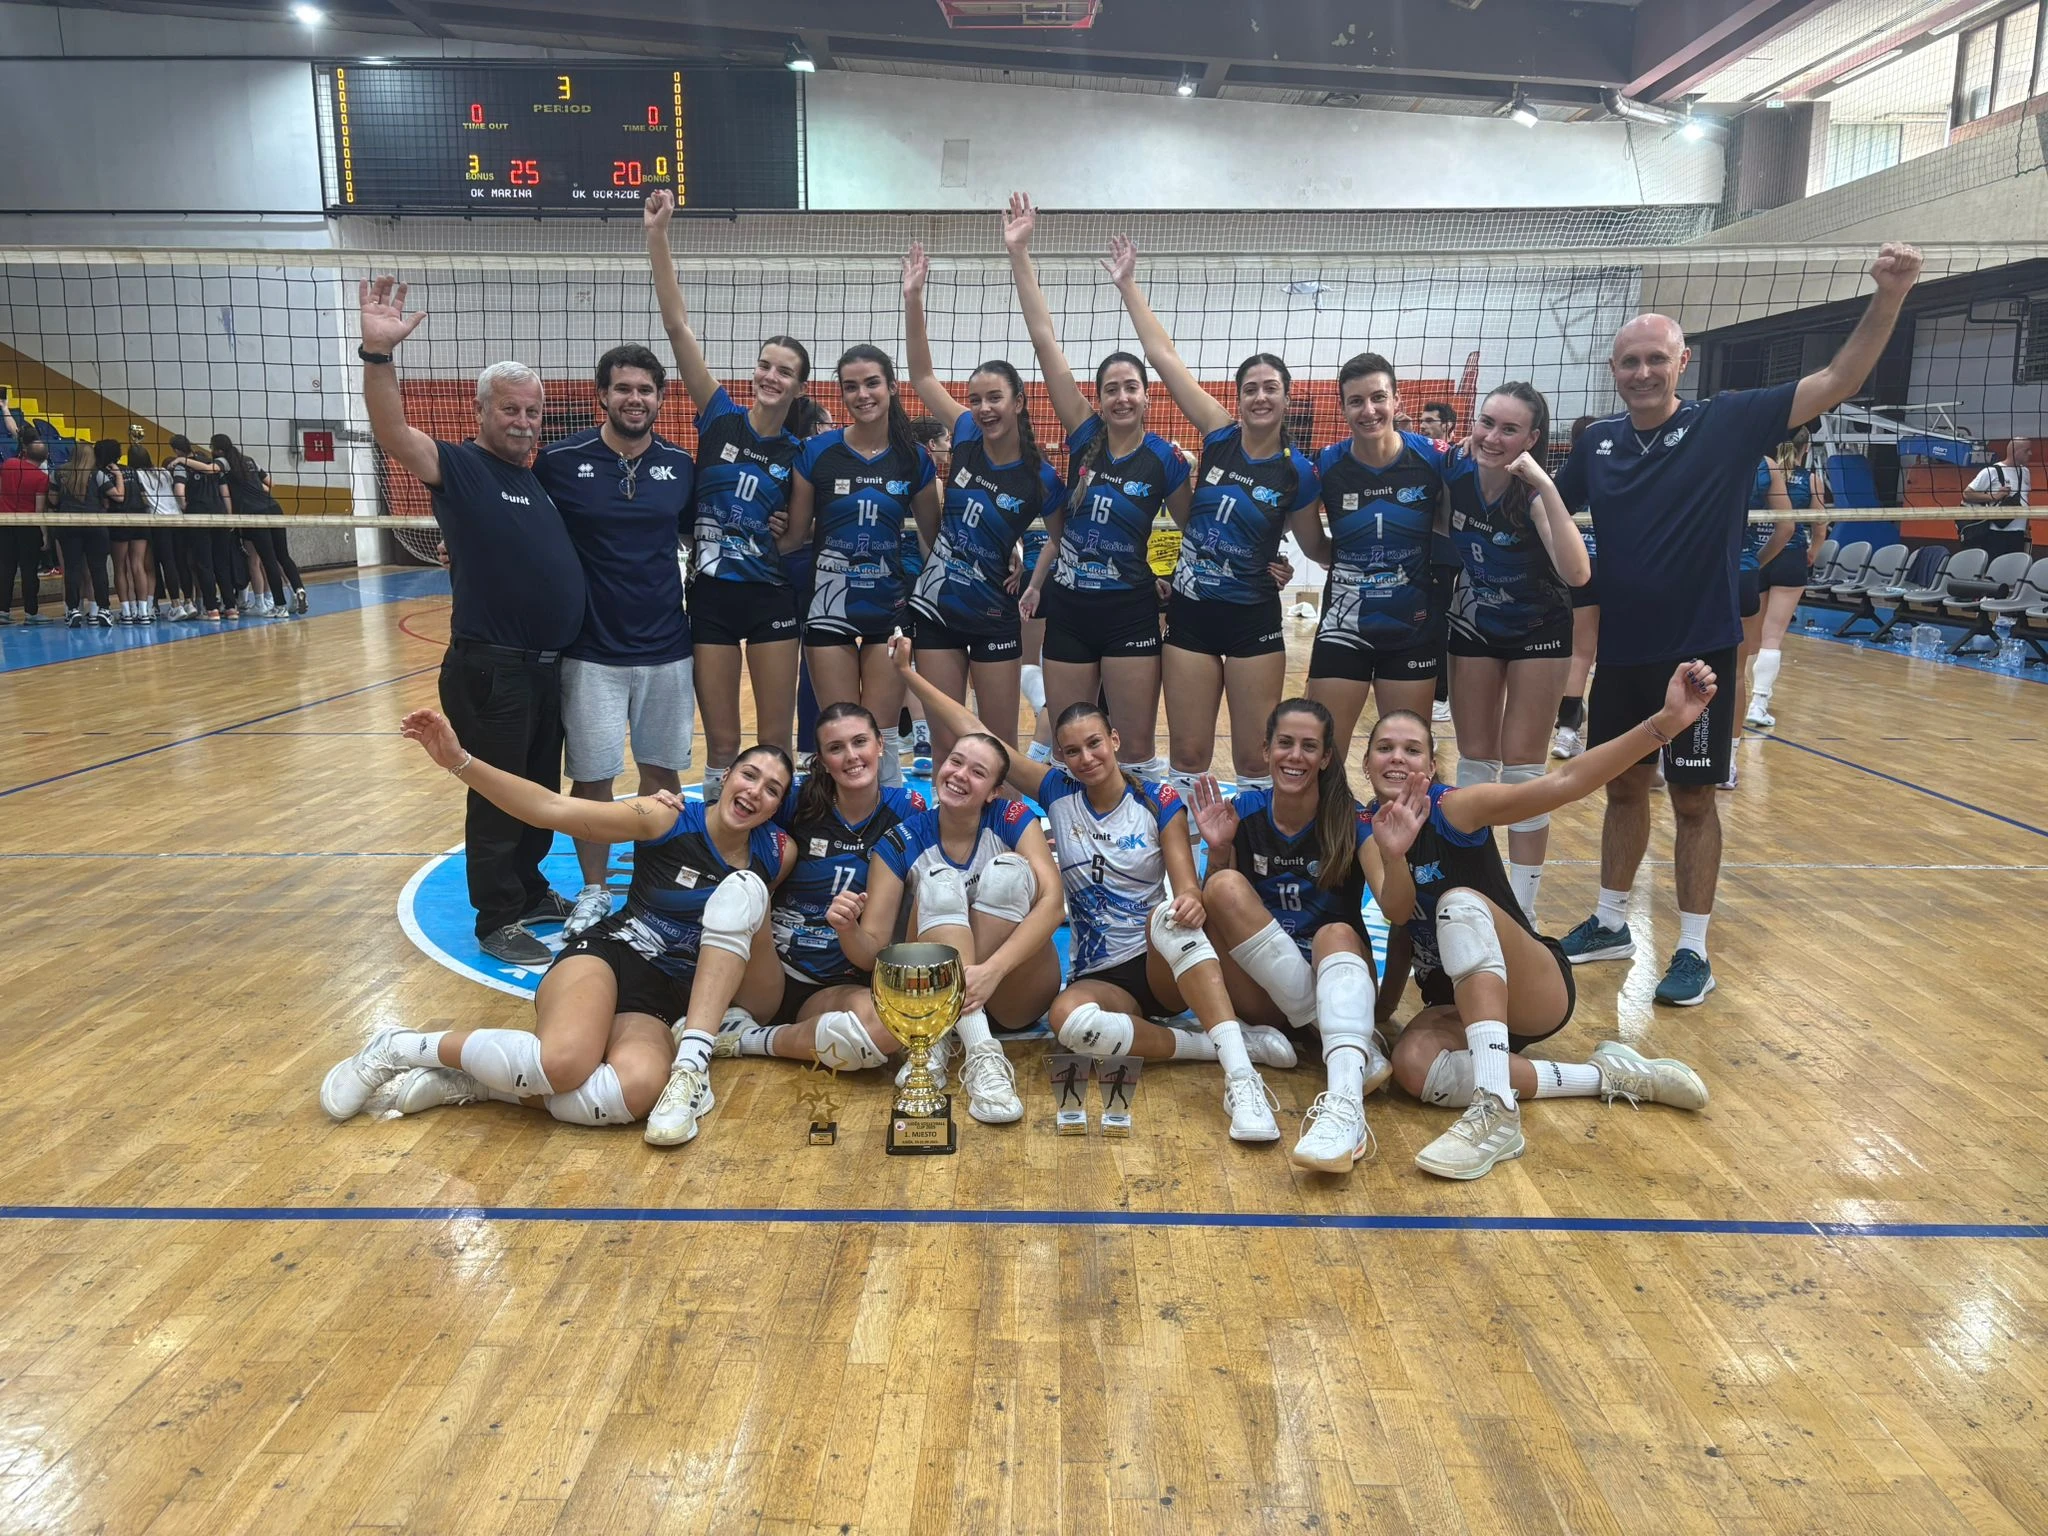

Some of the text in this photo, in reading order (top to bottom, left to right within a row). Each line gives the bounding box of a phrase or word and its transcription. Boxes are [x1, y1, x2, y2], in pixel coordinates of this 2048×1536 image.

[337, 68, 343, 78] 0
[674, 72, 680, 81] 0
[339, 80, 344, 90] 0
[558, 76, 571, 99] 3
[674, 83, 680, 93] 0
[340, 91, 345, 101] 0
[675, 94, 681, 104] 0
[341, 103, 346, 112] 0
[533, 104, 592, 113] PERIOD
[675, 106, 681, 116] 0
[471, 104, 483, 122] 0
[648, 106, 659, 124] 0
[341, 114, 347, 124] 0
[676, 117, 682, 127] 0
[342, 126, 348, 135] 0
[462, 122, 509, 130] TIME OUT
[676, 128, 682, 138] 0
[343, 137, 349, 147] 0
[677, 140, 683, 150] 0
[344, 148, 350, 158] 0
[677, 151, 683, 161] 0
[345, 159, 350, 169] 0
[469, 154, 479, 174] 3
[656, 156, 668, 175] 0
[678, 162, 684, 172] 0
[346, 171, 351, 180] 0
[465, 173, 494, 181] BONUS
[510, 160, 540, 184] 25
[613, 161, 641, 185] 20
[642, 175, 670, 183] BONUS
[678, 173, 684, 183] 0
[346, 182, 352, 191] 0
[679, 184, 684, 194] 0
[347, 192, 353, 203] 0
[470, 188, 532, 198] OK MARINA
[572, 190, 586, 199] OK
[679, 195, 685, 205] 0
[734, 471, 759, 502] 10
[857, 499, 878, 527] 14
[961, 497, 984, 529] 16
[1090, 494, 1113, 524] 15
[1215, 494, 1237, 524] 11
[1374, 512, 1383, 539] 1
[1470, 542, 1485, 563] 8
[1685, 757, 1711, 768] unit
[830, 866, 856, 896] 17
[1276, 883, 1302, 912] 13
